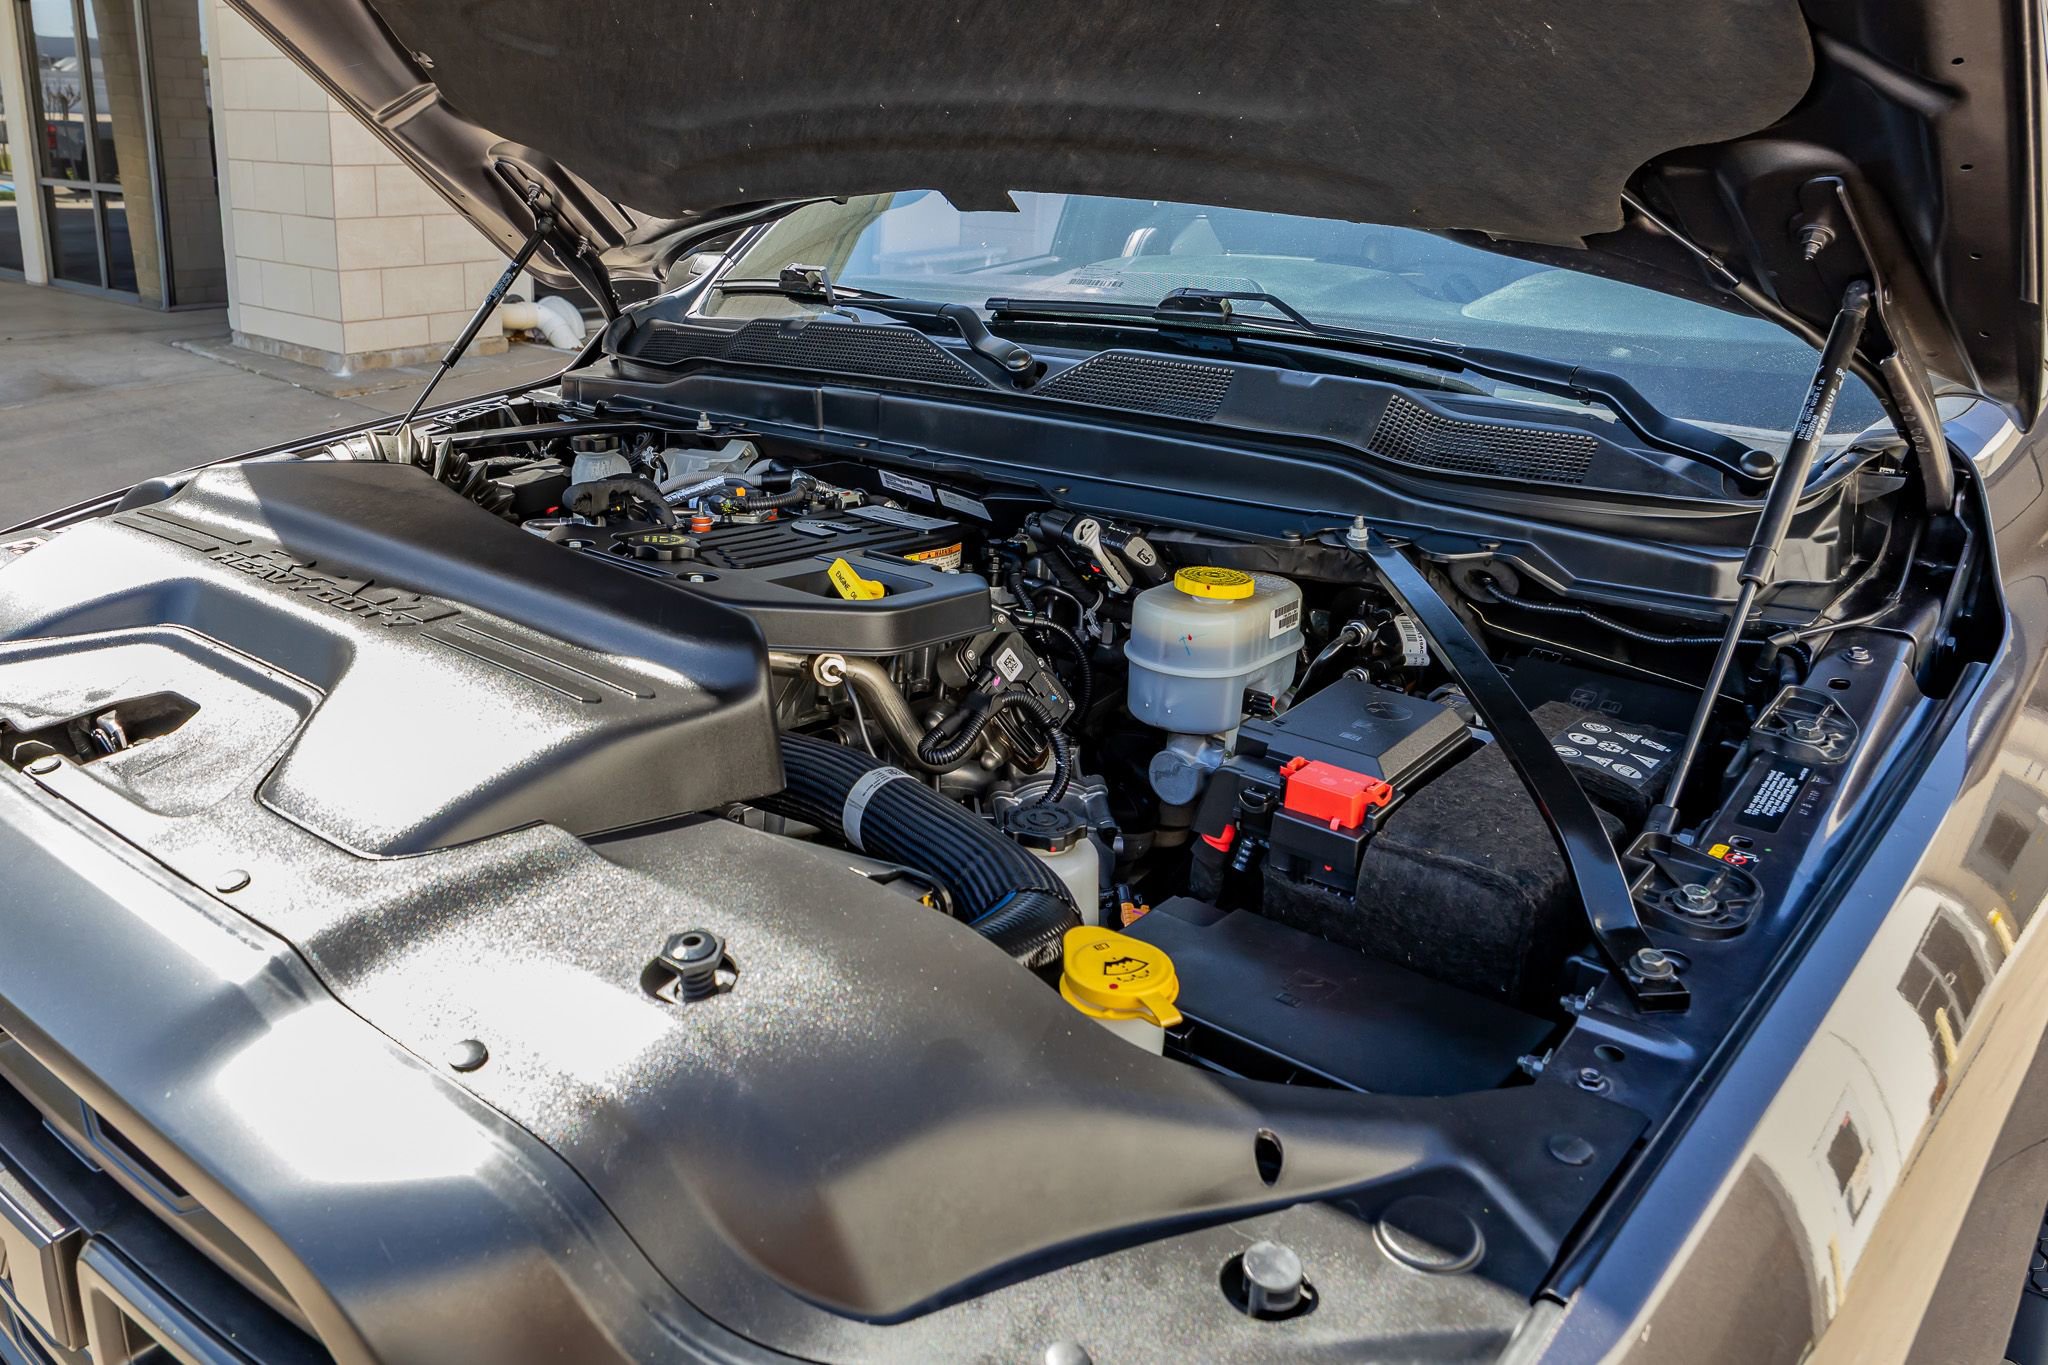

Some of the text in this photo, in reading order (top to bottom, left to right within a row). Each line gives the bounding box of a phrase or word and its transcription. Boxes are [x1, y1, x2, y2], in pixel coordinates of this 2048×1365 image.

[209, 552, 417, 628] HEAVY DUTY
[835, 570, 851, 591] ENGINE
[1040, 671, 1064, 704] Cummins
